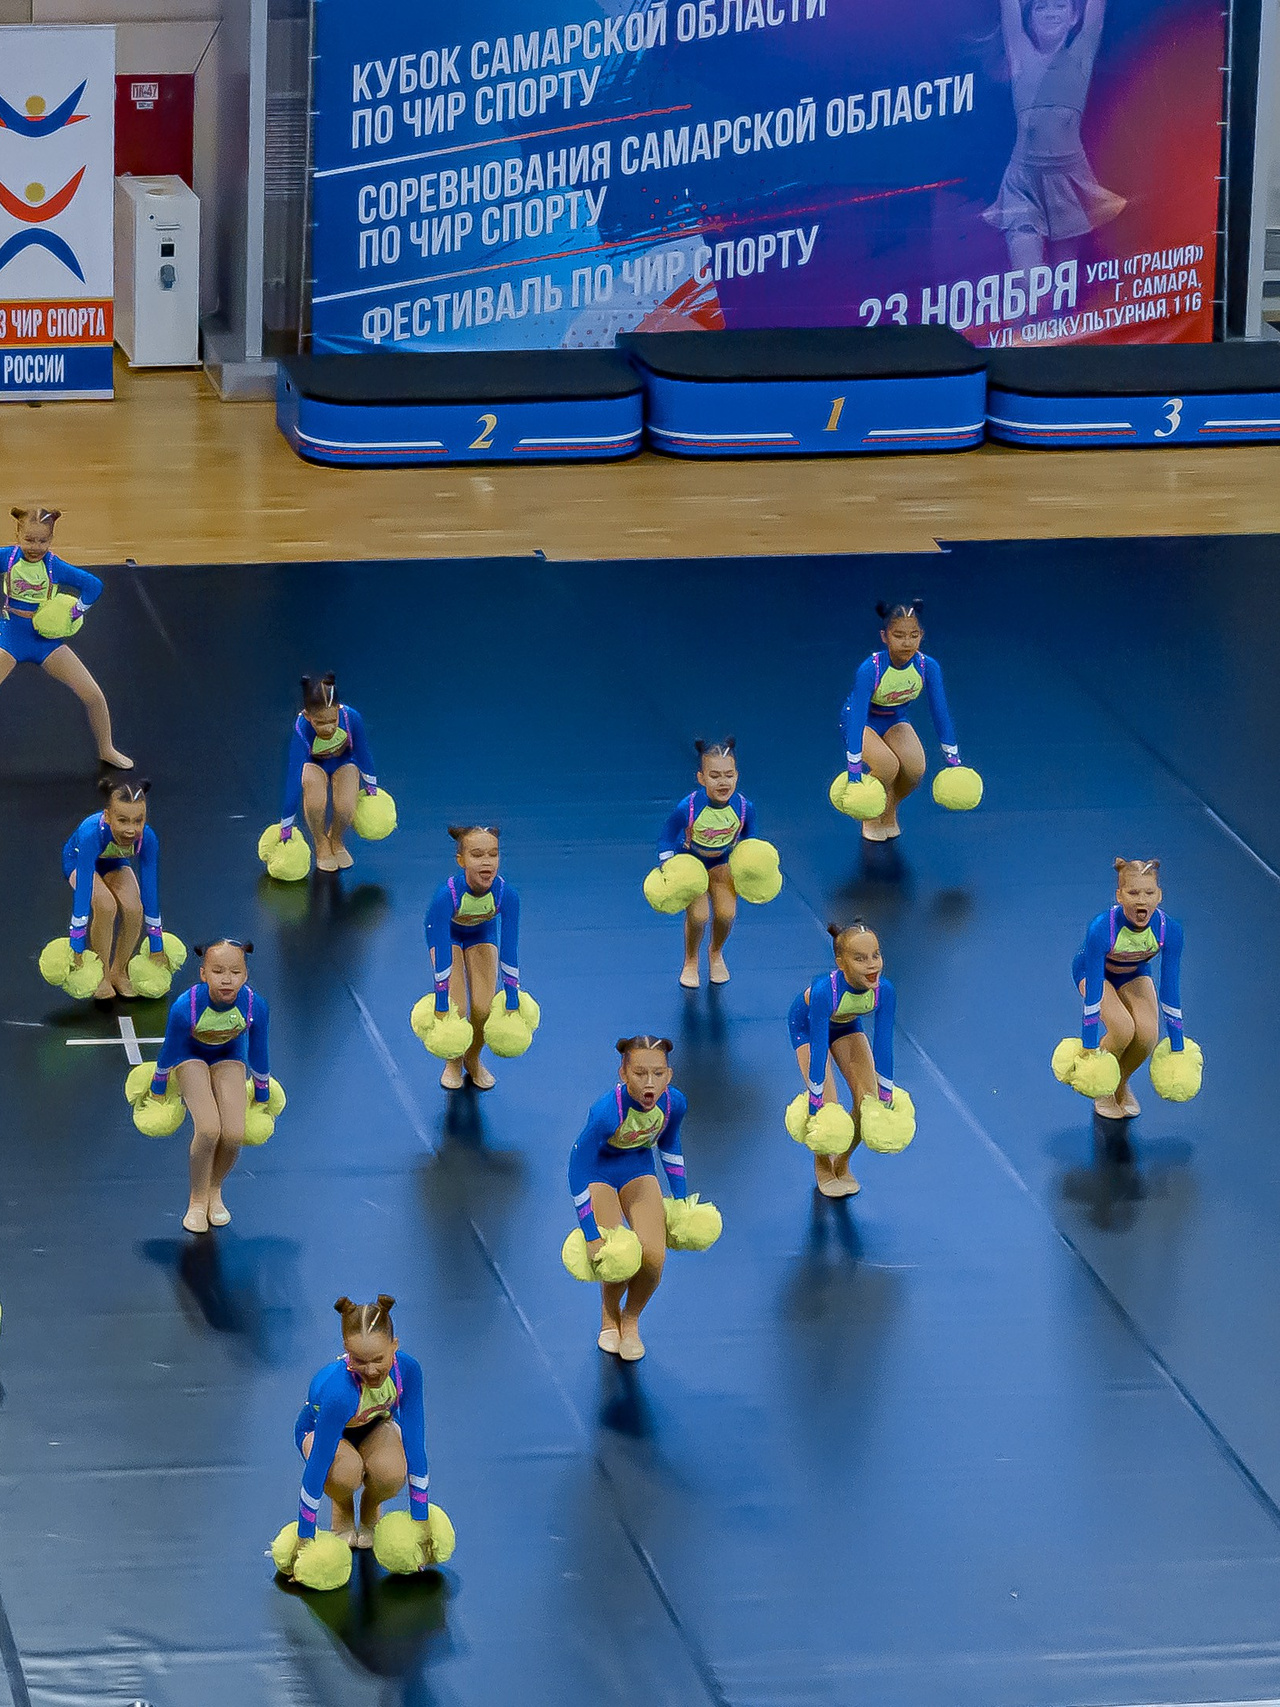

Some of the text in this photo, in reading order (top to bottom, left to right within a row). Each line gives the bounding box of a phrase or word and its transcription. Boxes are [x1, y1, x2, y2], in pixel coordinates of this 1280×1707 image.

[351, 45, 461, 103] КУБОК
[471, 1, 667, 81] САМАРСКОЙ
[351, 66, 602, 149] ПО ЧИР СПОРТУ
[358, 73, 975, 225] СОРЕВНОВАНИЯ САМАРСКОЙ ОБЛАСТИ
[358, 187, 608, 269] ПО ЧИР СПОРТУ
[1086, 245, 1204, 284] УСЦ «ГРАЦИЯ»
[361, 225, 819, 346] ФЕСТИВАЛЬ ПО ЧИР СПОРТУ
[859, 260, 1078, 330] 23 НОЯБРЯ
[1114, 269, 1202, 302] Г. САМАРА,
[1175, 292, 1202, 315] 116
[11, 309, 43, 339] ЧИР
[47, 307, 106, 338] СПОРТА
[3, 355, 65, 384] РОССИИ
[468, 413, 497, 449] 2
[823, 396, 846, 431] 1
[1154, 398, 1183, 438] 3
